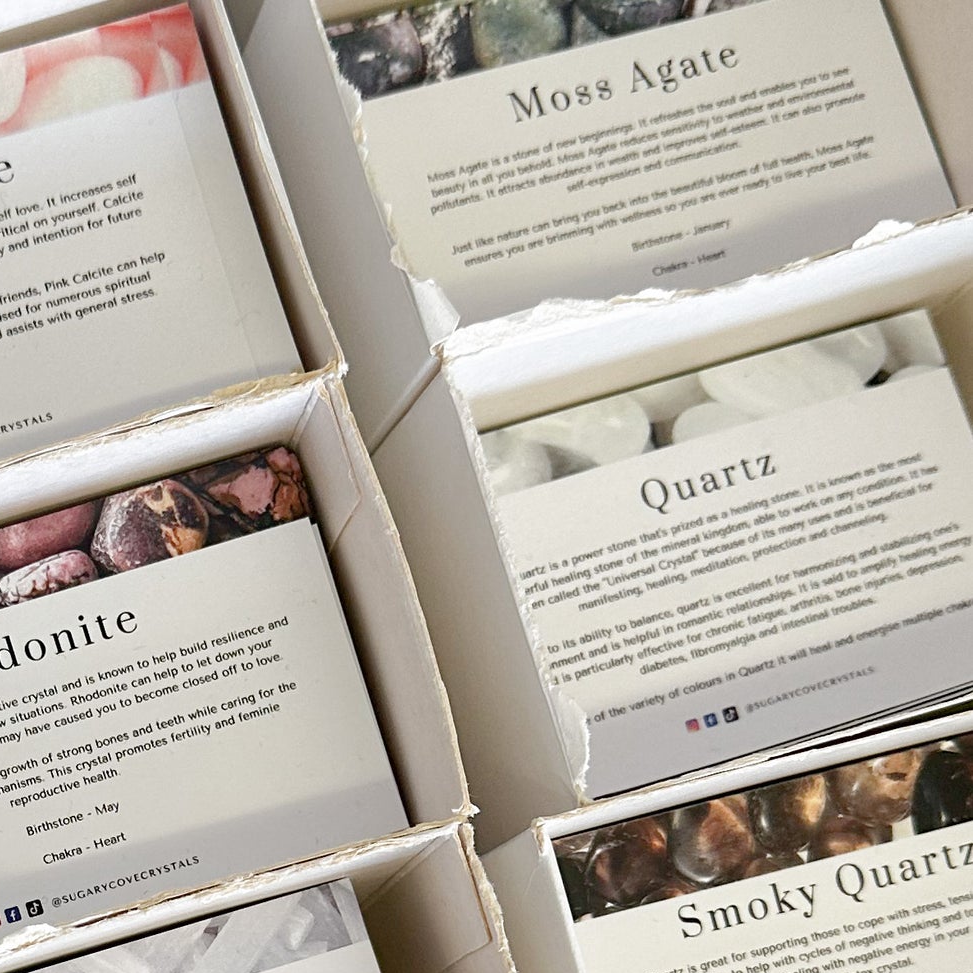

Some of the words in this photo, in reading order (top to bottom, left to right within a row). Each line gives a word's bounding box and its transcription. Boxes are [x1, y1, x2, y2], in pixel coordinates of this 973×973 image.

[507, 79, 612, 122] Moss
[630, 48, 738, 93] Agate
[640, 454, 776, 515] Quartz
[9, 780, 80, 807] reproductive
[82, 767, 120, 785] health.
[25, 813, 83, 836] Birthstone
[94, 802, 119, 815] May
[51, 855, 199, 908] @SUGARYCOVECRYSTALS
[677, 882, 816, 938] Smoky
[835, 842, 973, 902] Quartz
[876, 956, 917, 973] crystal.
